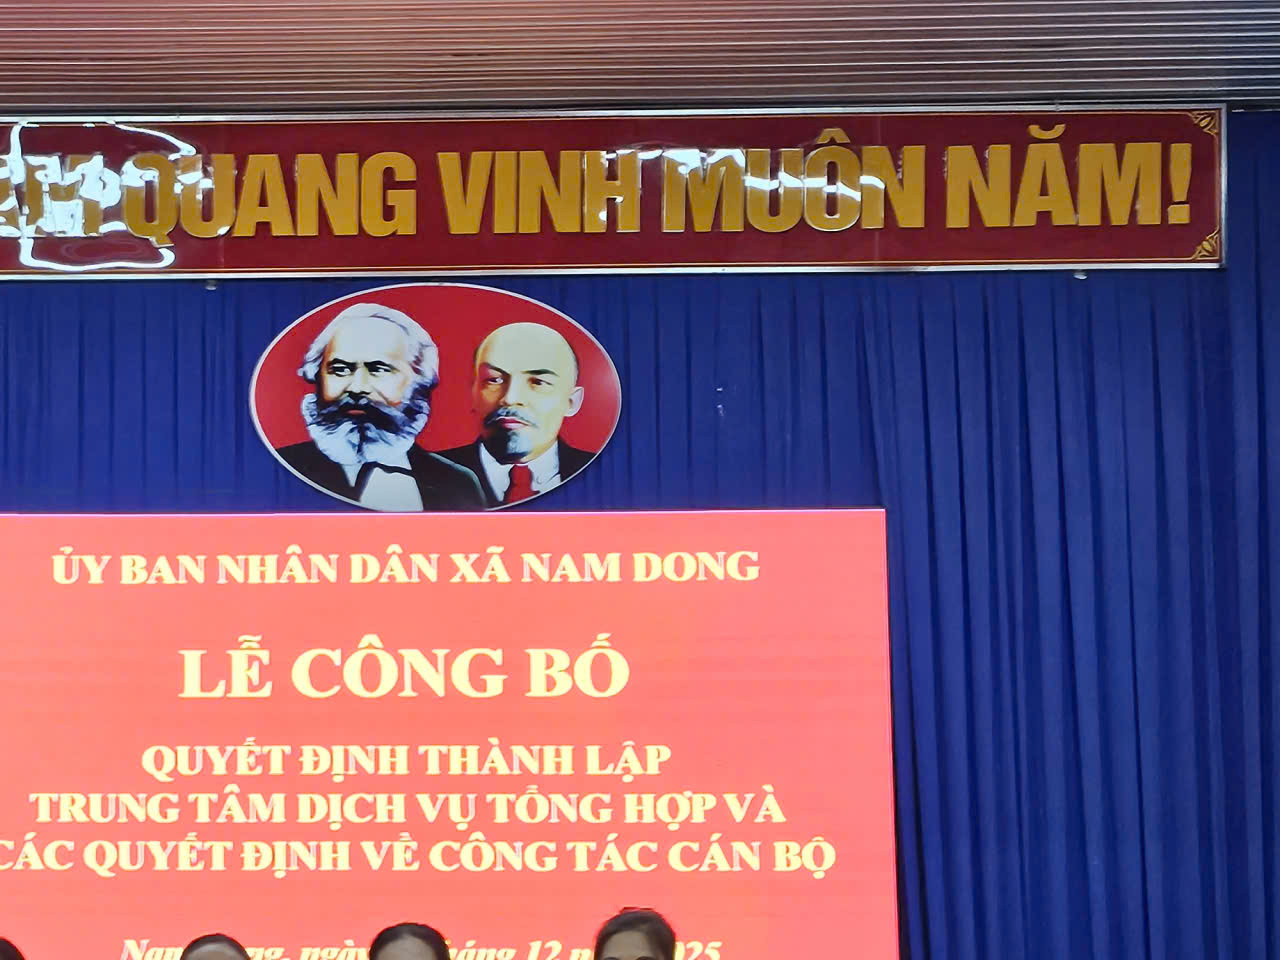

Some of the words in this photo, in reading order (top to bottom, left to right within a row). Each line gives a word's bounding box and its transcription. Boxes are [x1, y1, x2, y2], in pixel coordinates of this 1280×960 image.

[122, 151, 417, 247] QUANG
[437, 150, 641, 234] VINH
[662, 128, 926, 233] MUÔN
[945, 124, 1193, 230] NĂM!
[52, 546, 112, 584] ỦY
[120, 555, 206, 584] BAN
[217, 544, 339, 584] NHÂN
[350, 544, 439, 583] DÂN
[450, 546, 511, 583] XÃ
[521, 553, 621, 582] NAM
[633, 551, 759, 582] DONG
[178, 635, 272, 697] LỄ
[291, 634, 507, 698] CÔNG
[525, 633, 629, 697] BỐ
[142, 737, 291, 782] QUYẾT
[299, 745, 409, 783] ĐỊNH
[418, 737, 574, 775] THÀNH
[586, 741, 671, 782] LẬP
[29, 793, 180, 823] TRUNG
[188, 784, 286, 823] TÂM
[297, 793, 406, 830] DỊCH
[416, 794, 476, 830] VỤ
[624, 791, 716, 831] HỢP
[723, 784, 786, 823] VÀ
[83, 832, 233, 877] QUYẾT
[240, 841, 350, 878] ĐỊNH
[360, 832, 420, 870] VỀ
[429, 831, 557, 872] CÔNG
[566, 833, 658, 872] TÁC
[668, 830, 760, 872] CÁN
[773, 837, 836, 879] BỘ
